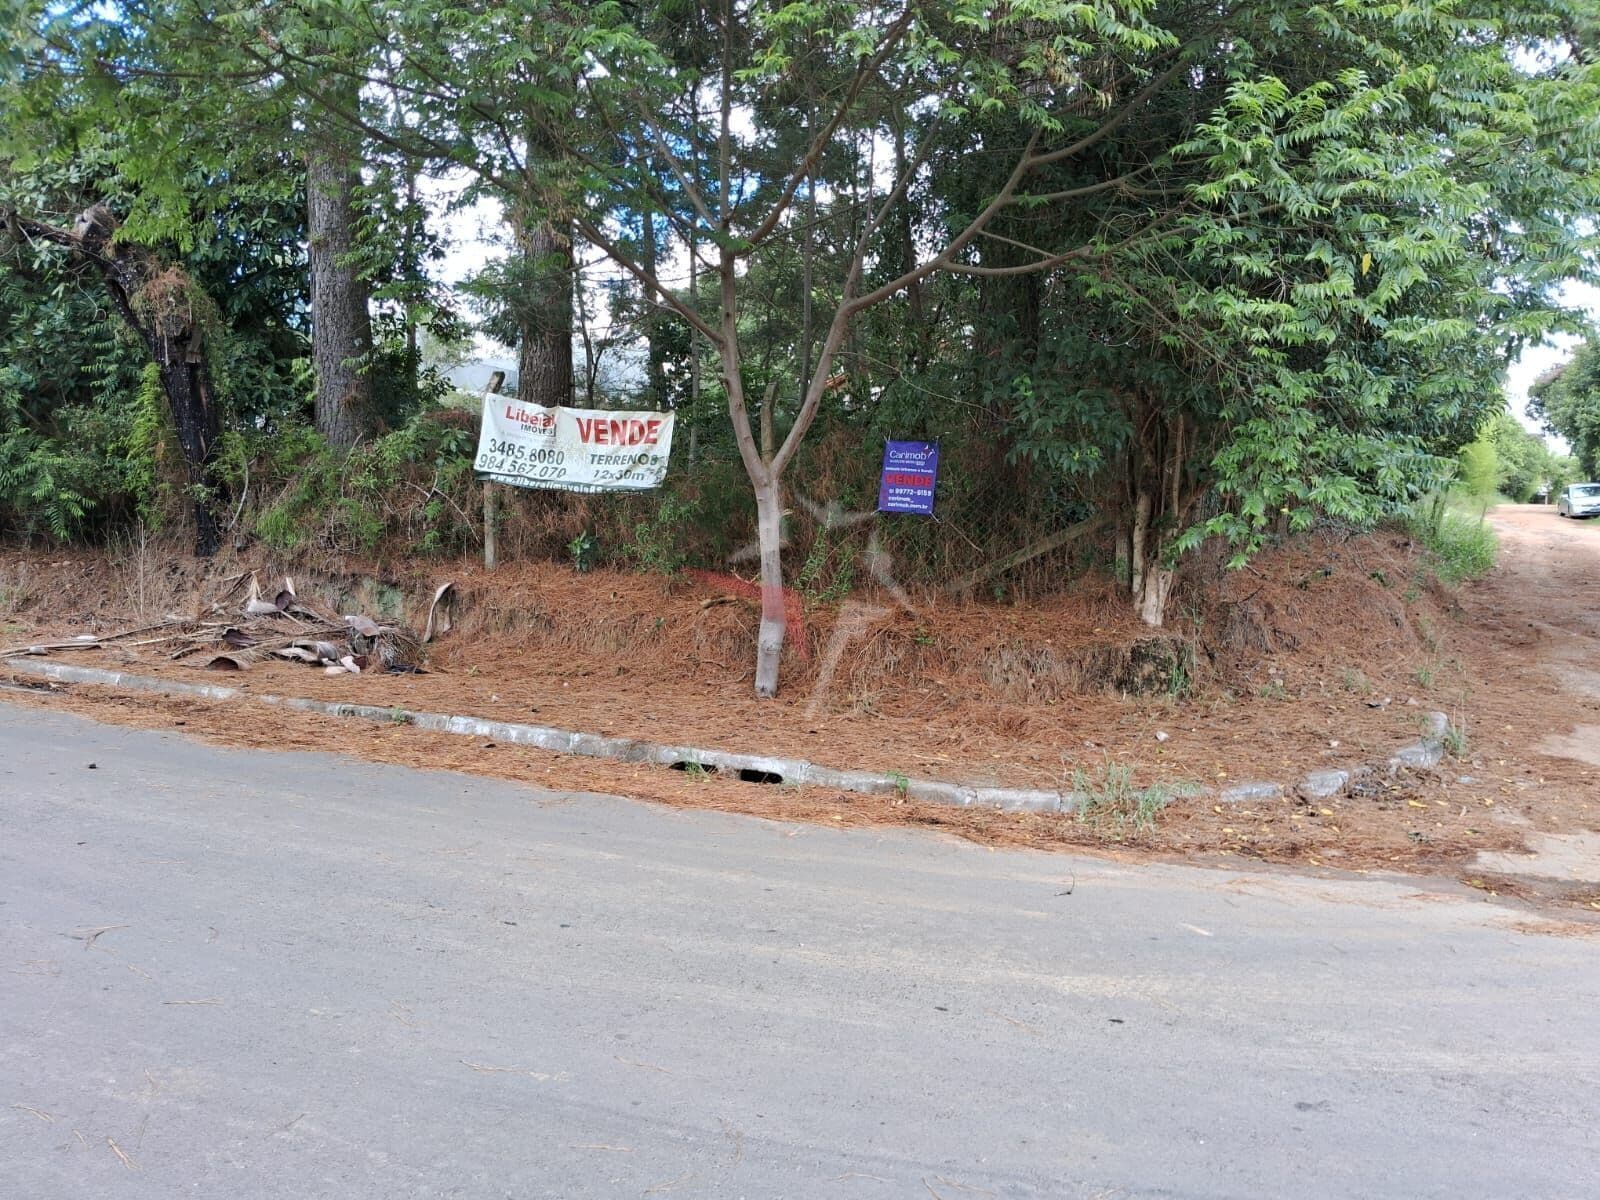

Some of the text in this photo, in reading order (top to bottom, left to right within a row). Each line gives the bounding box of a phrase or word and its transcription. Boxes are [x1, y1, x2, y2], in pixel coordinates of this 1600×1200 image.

[505, 405, 556, 427] Liberal
[576, 417, 662, 446] VENDE
[489, 438, 565, 465] 3485.8080
[478, 453, 567, 479] 984.567.070
[886, 473, 932, 488] VENDE
